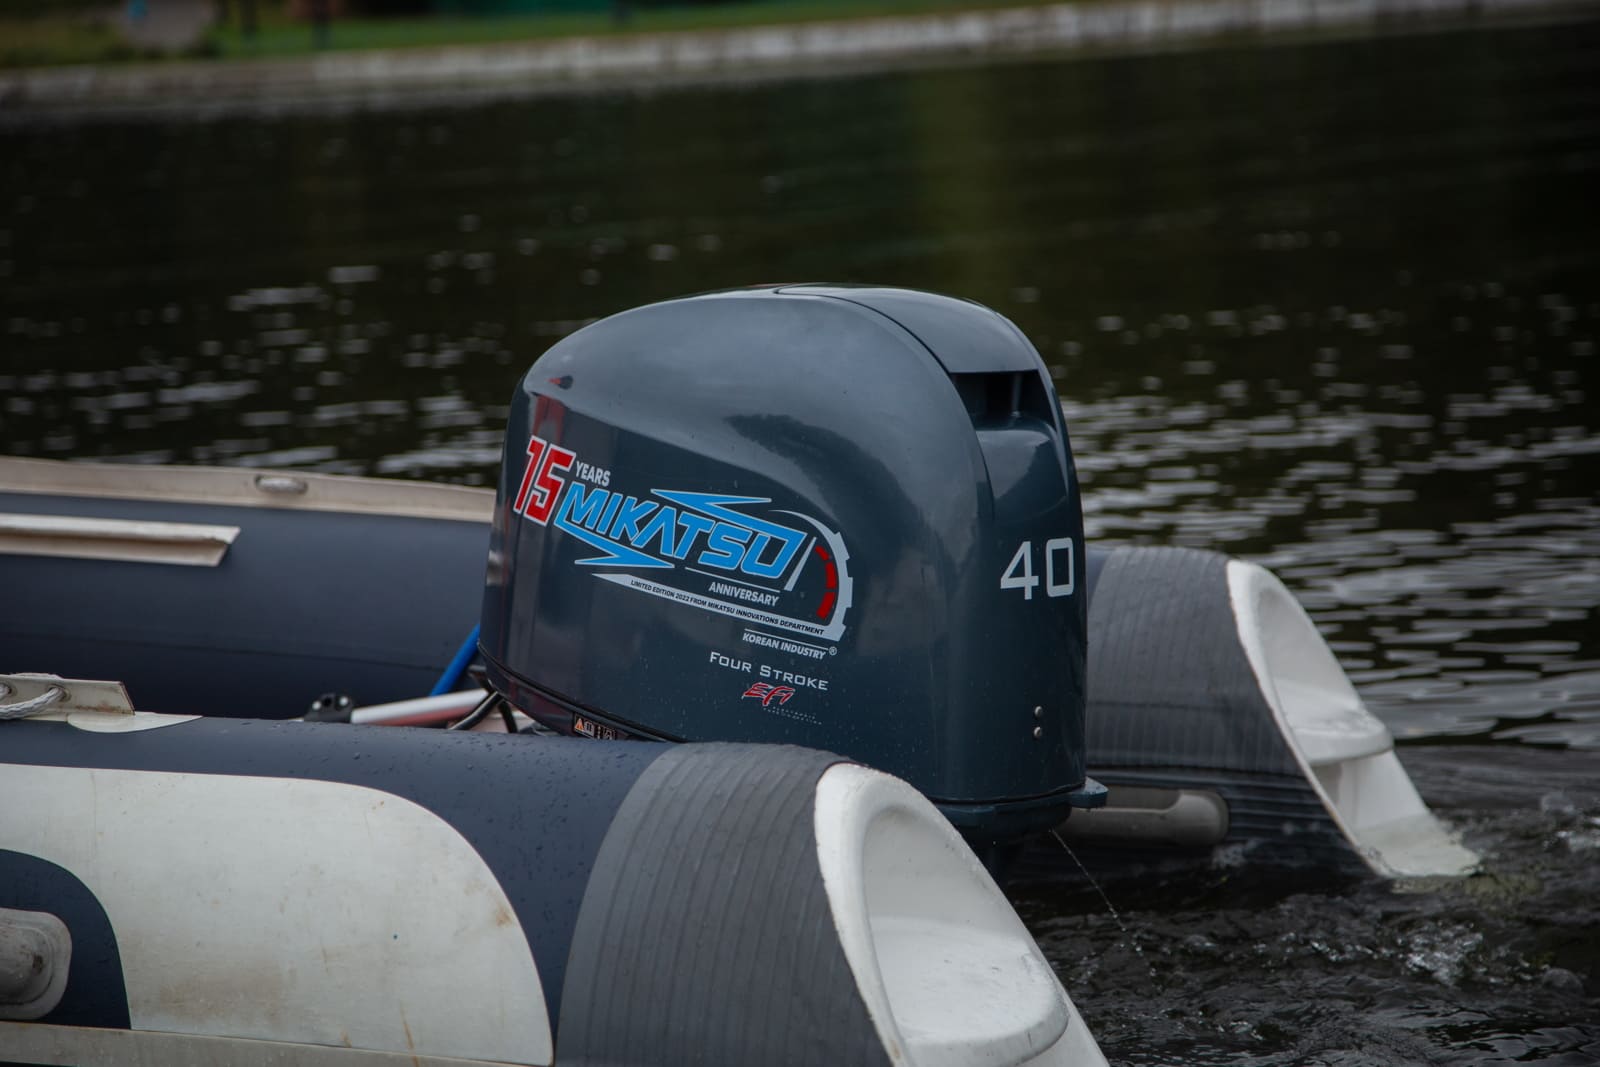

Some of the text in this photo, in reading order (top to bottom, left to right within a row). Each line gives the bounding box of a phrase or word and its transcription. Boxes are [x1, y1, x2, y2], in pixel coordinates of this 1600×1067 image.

[513, 434, 577, 527] 15
[575, 460, 612, 487] YEARS
[1000, 537, 1074, 600] 40
[630, 579, 825, 636] LIMITED EDITION 2022 FROM MIKATSU INNOVATIONS DEPARTMENT
[708, 581, 780, 607] ANNIVERSARY
[742, 632, 779, 650] KOREAN
[780, 642, 827, 660] INDUSTRY
